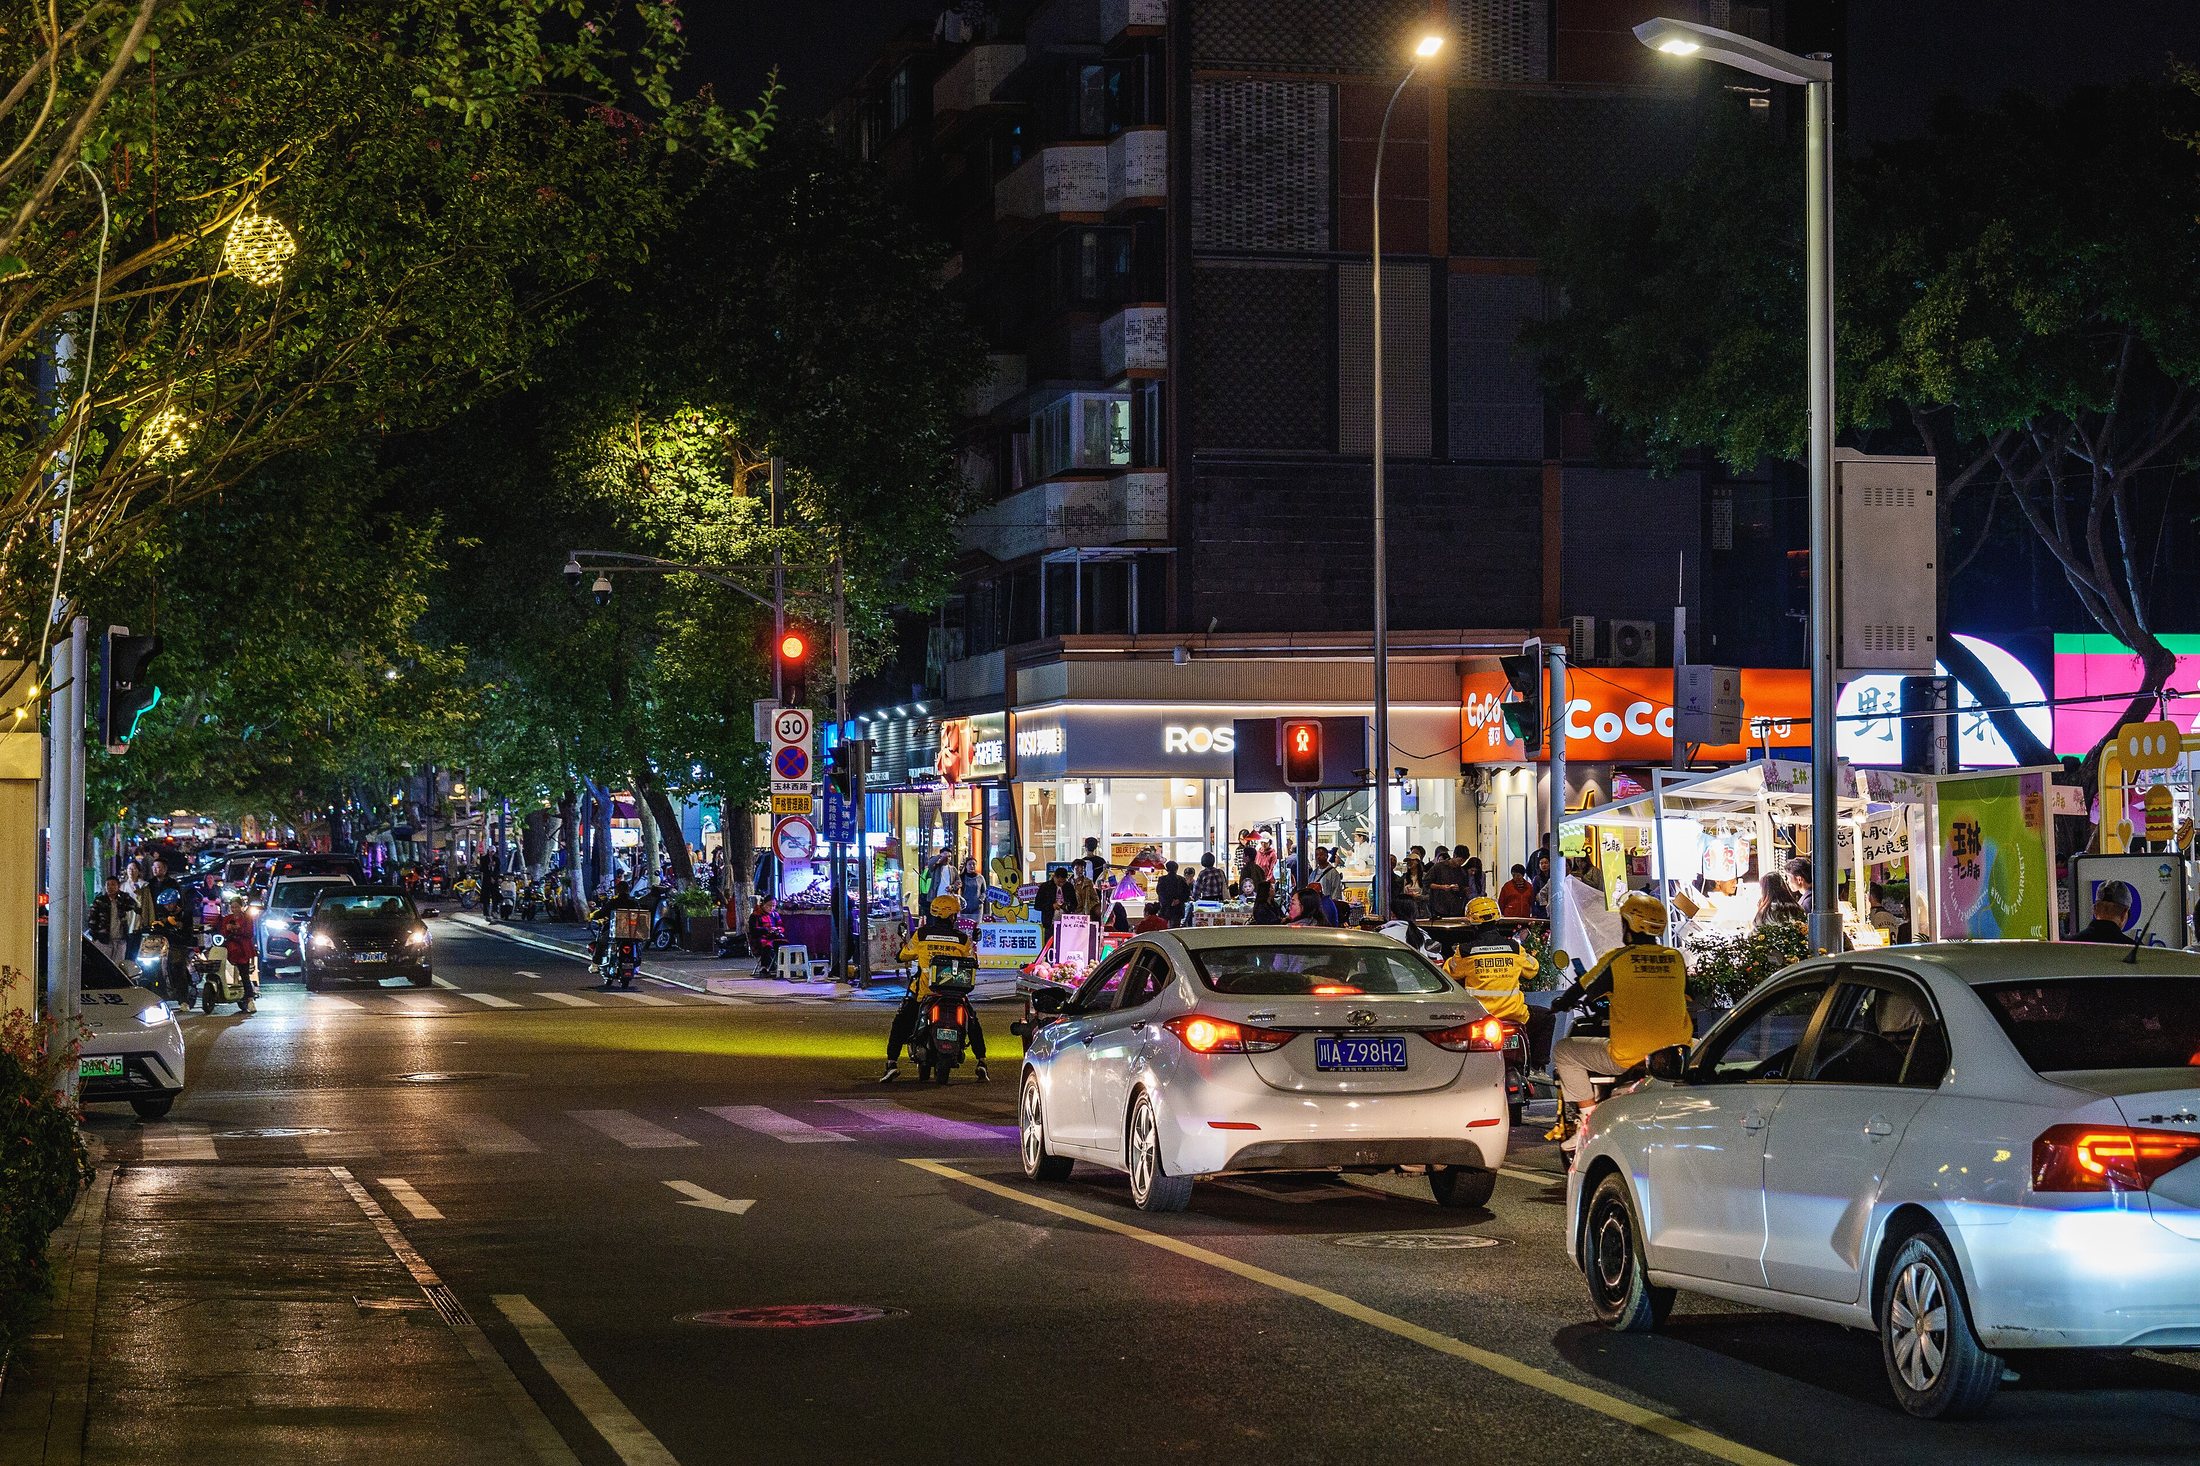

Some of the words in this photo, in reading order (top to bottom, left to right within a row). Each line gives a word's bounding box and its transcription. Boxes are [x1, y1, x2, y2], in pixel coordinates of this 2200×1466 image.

[1467, 692, 1500, 730] CoCo
[1565, 699, 1673, 743] CoCo
[781, 719, 802, 735] 30
[1750, 716, 1793, 739] 都可
[773, 782, 808, 791] 玉林西路
[774, 797, 810, 811] 严格管理路段
[828, 796, 837, 838] 此路段禁止
[1952, 820, 1982, 857] 玉林
[999, 936, 1037, 949] 乐活街区
[1473, 957, 1514, 968] 美团团购
[1320, 1043, 1404, 1063] 川A·Z98H2
